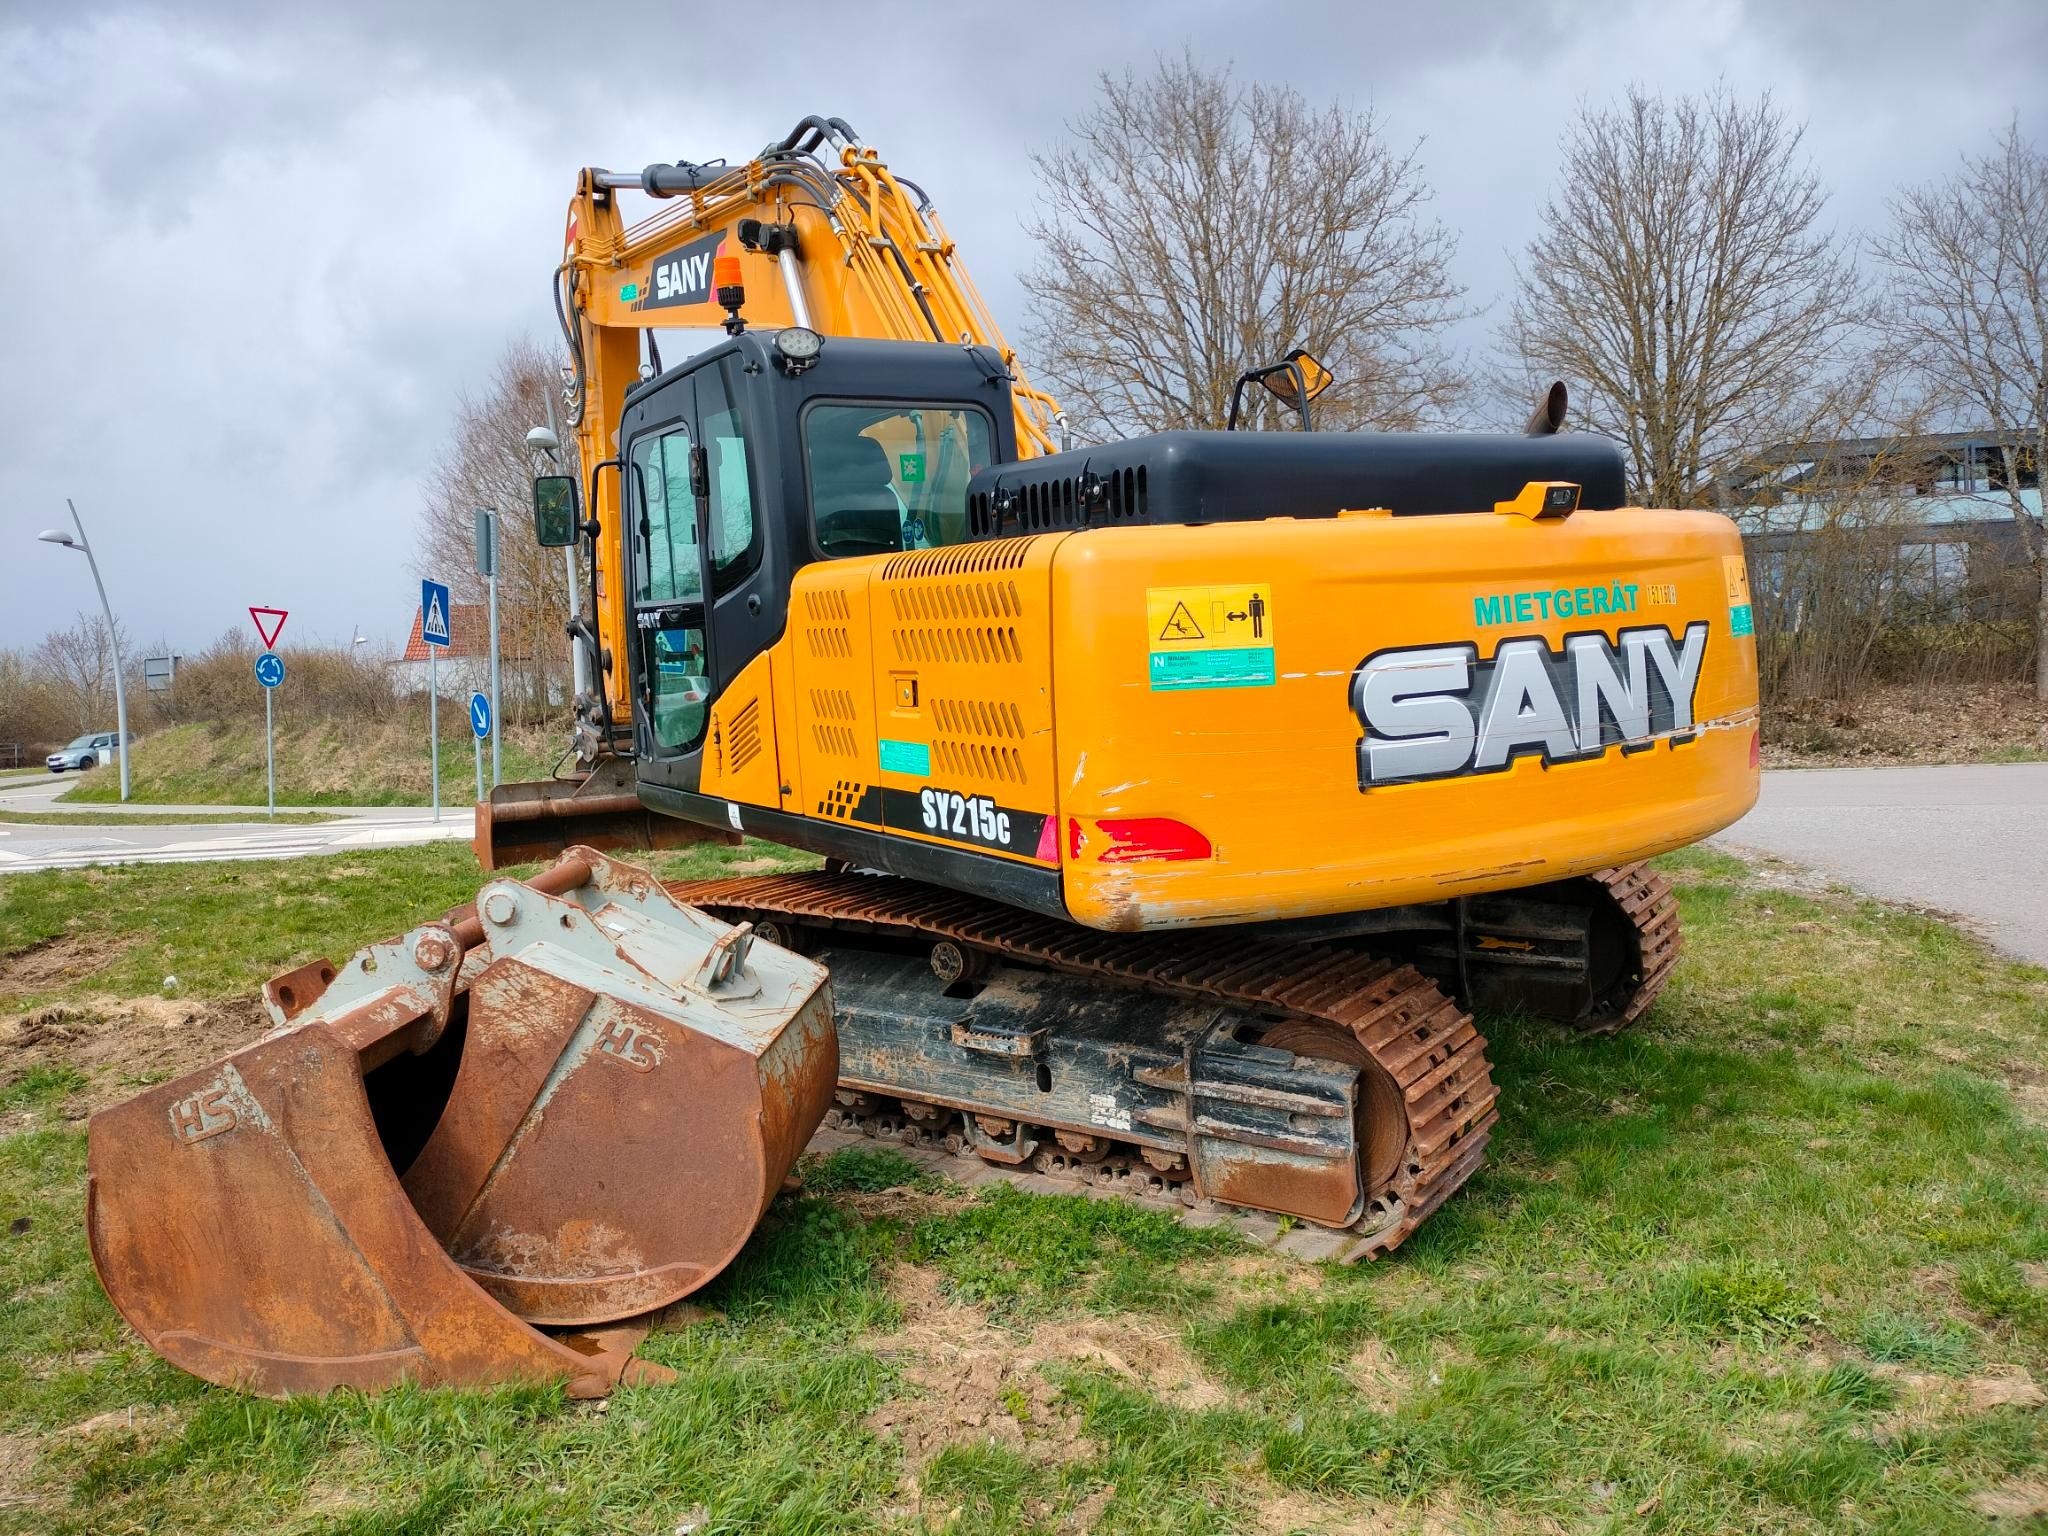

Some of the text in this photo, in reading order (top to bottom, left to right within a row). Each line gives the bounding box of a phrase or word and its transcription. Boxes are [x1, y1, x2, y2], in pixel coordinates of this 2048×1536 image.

[656, 252, 710, 300] SANY
[1473, 579, 1639, 627] MIETGERÄT
[1352, 622, 1709, 788] SANY
[591, 1019, 661, 1074] HS
[171, 1090, 237, 1146] HS
